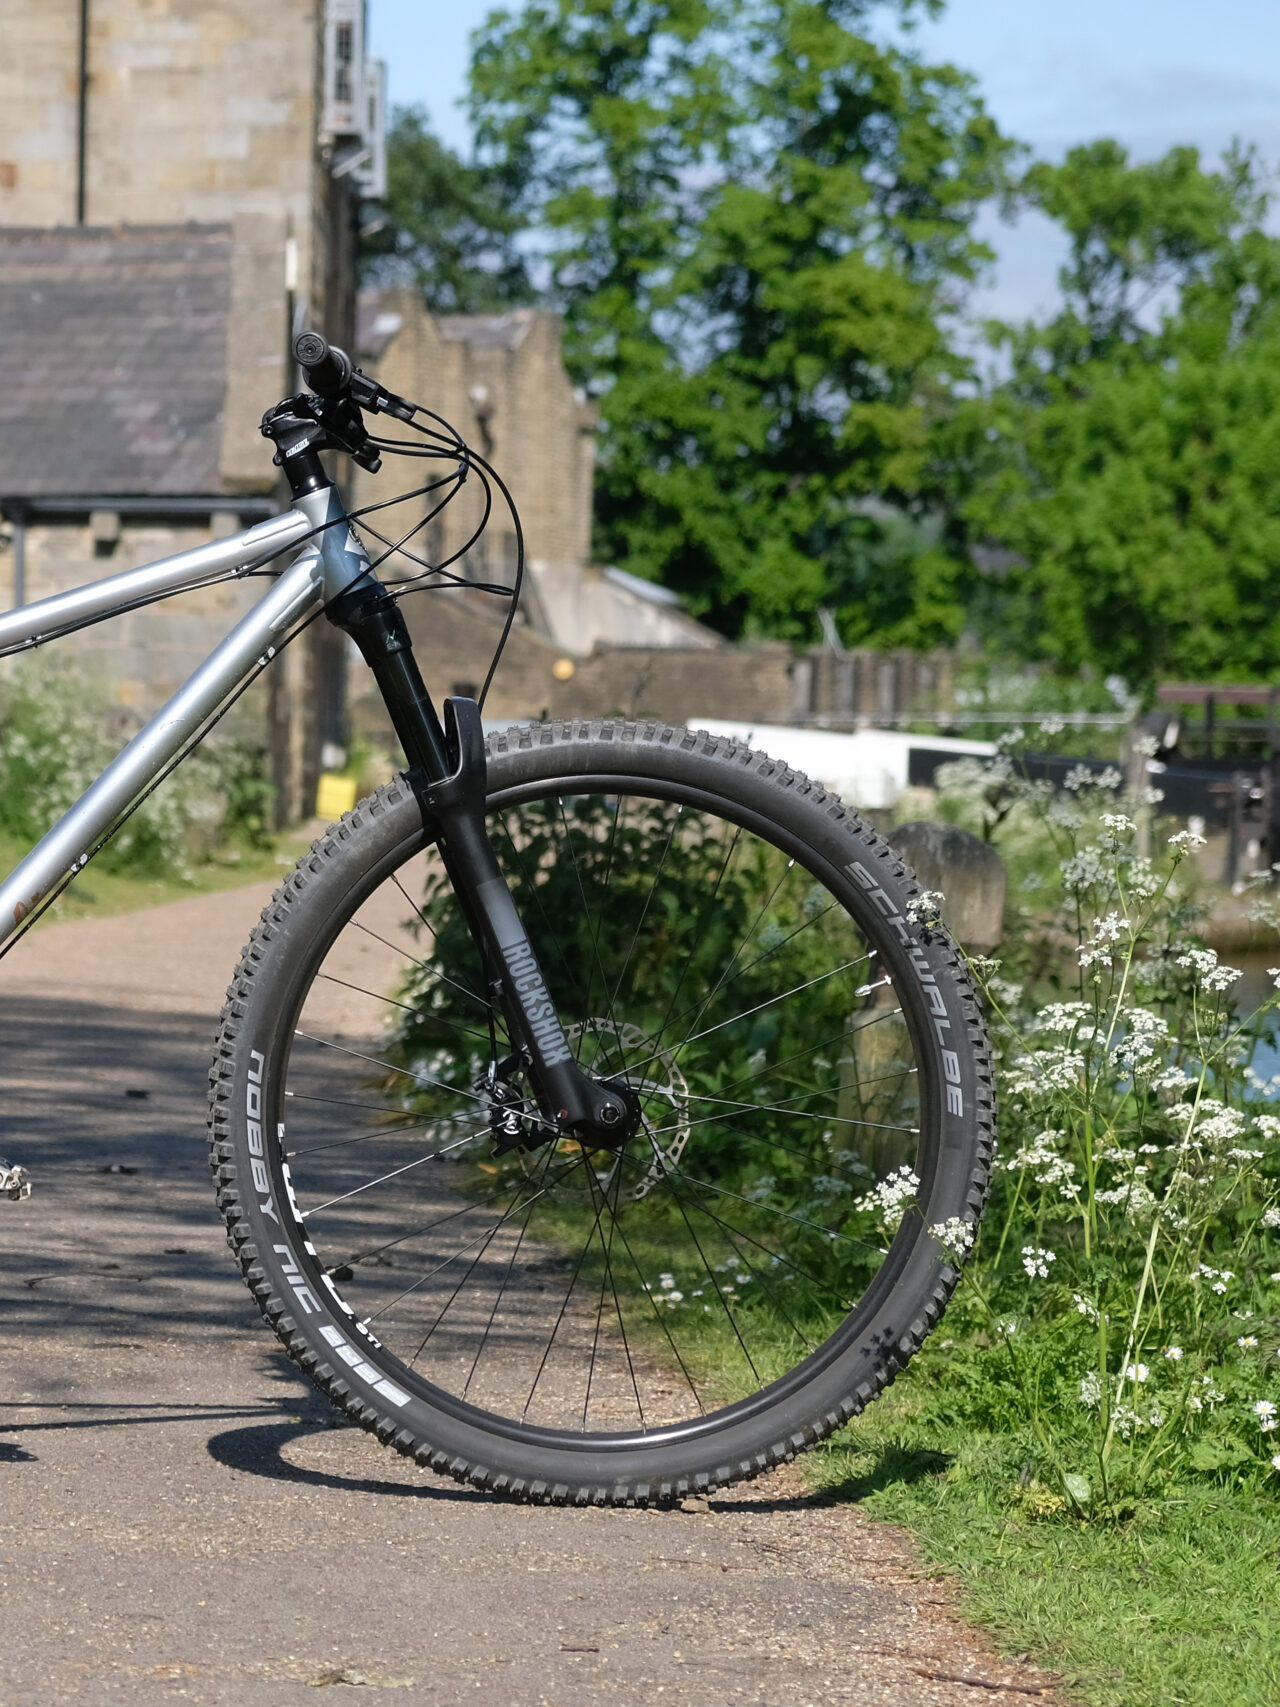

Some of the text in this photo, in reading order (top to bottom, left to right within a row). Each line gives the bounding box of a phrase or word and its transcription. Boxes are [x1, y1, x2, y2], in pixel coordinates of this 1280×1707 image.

[502, 939, 574, 1068] ROCKSHOX
[845, 861, 964, 1118] SCHWALBE
[245, 1049, 280, 1226] NOBBY
[272, 1244, 322, 1315] NIC
